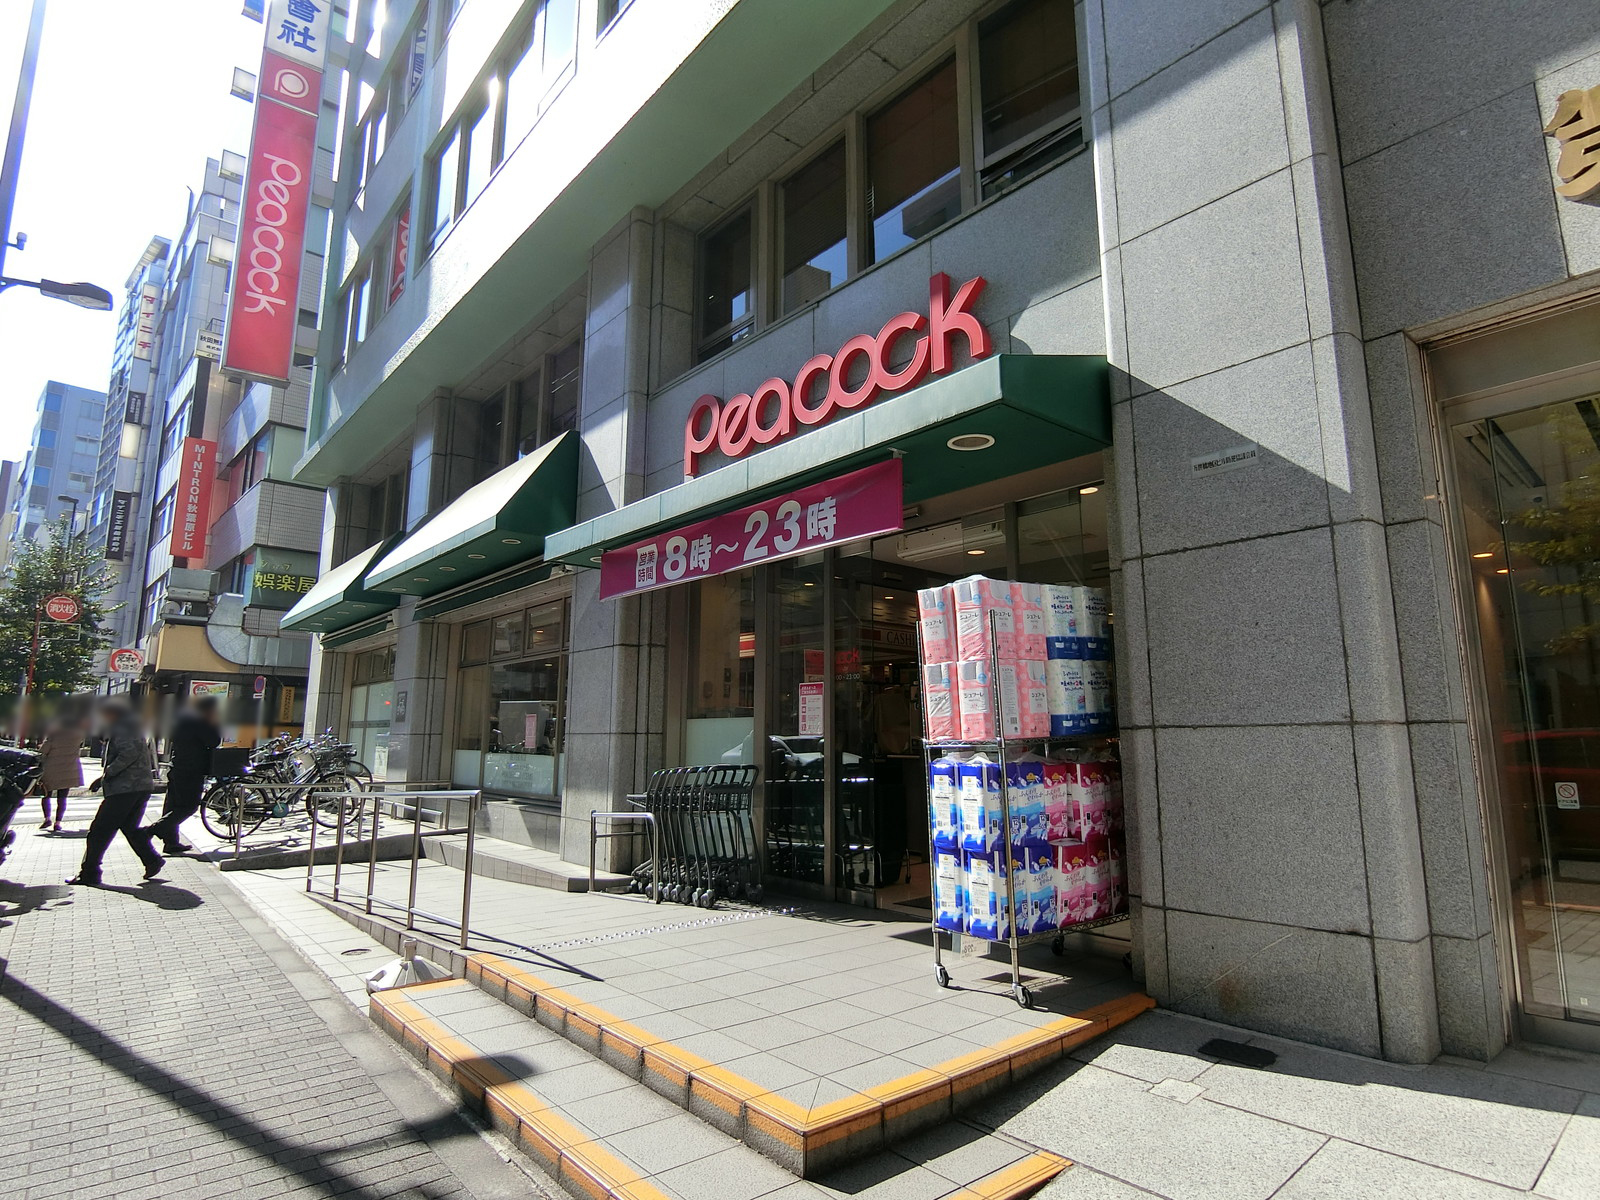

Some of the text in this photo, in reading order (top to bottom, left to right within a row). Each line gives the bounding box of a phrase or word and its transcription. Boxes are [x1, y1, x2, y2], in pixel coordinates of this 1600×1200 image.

[244, 153, 302, 317] peacock
[684, 272, 993, 476] peacock
[49, 603, 75, 614] 消火栓
[255, 571, 316, 594] 娯楽屋
